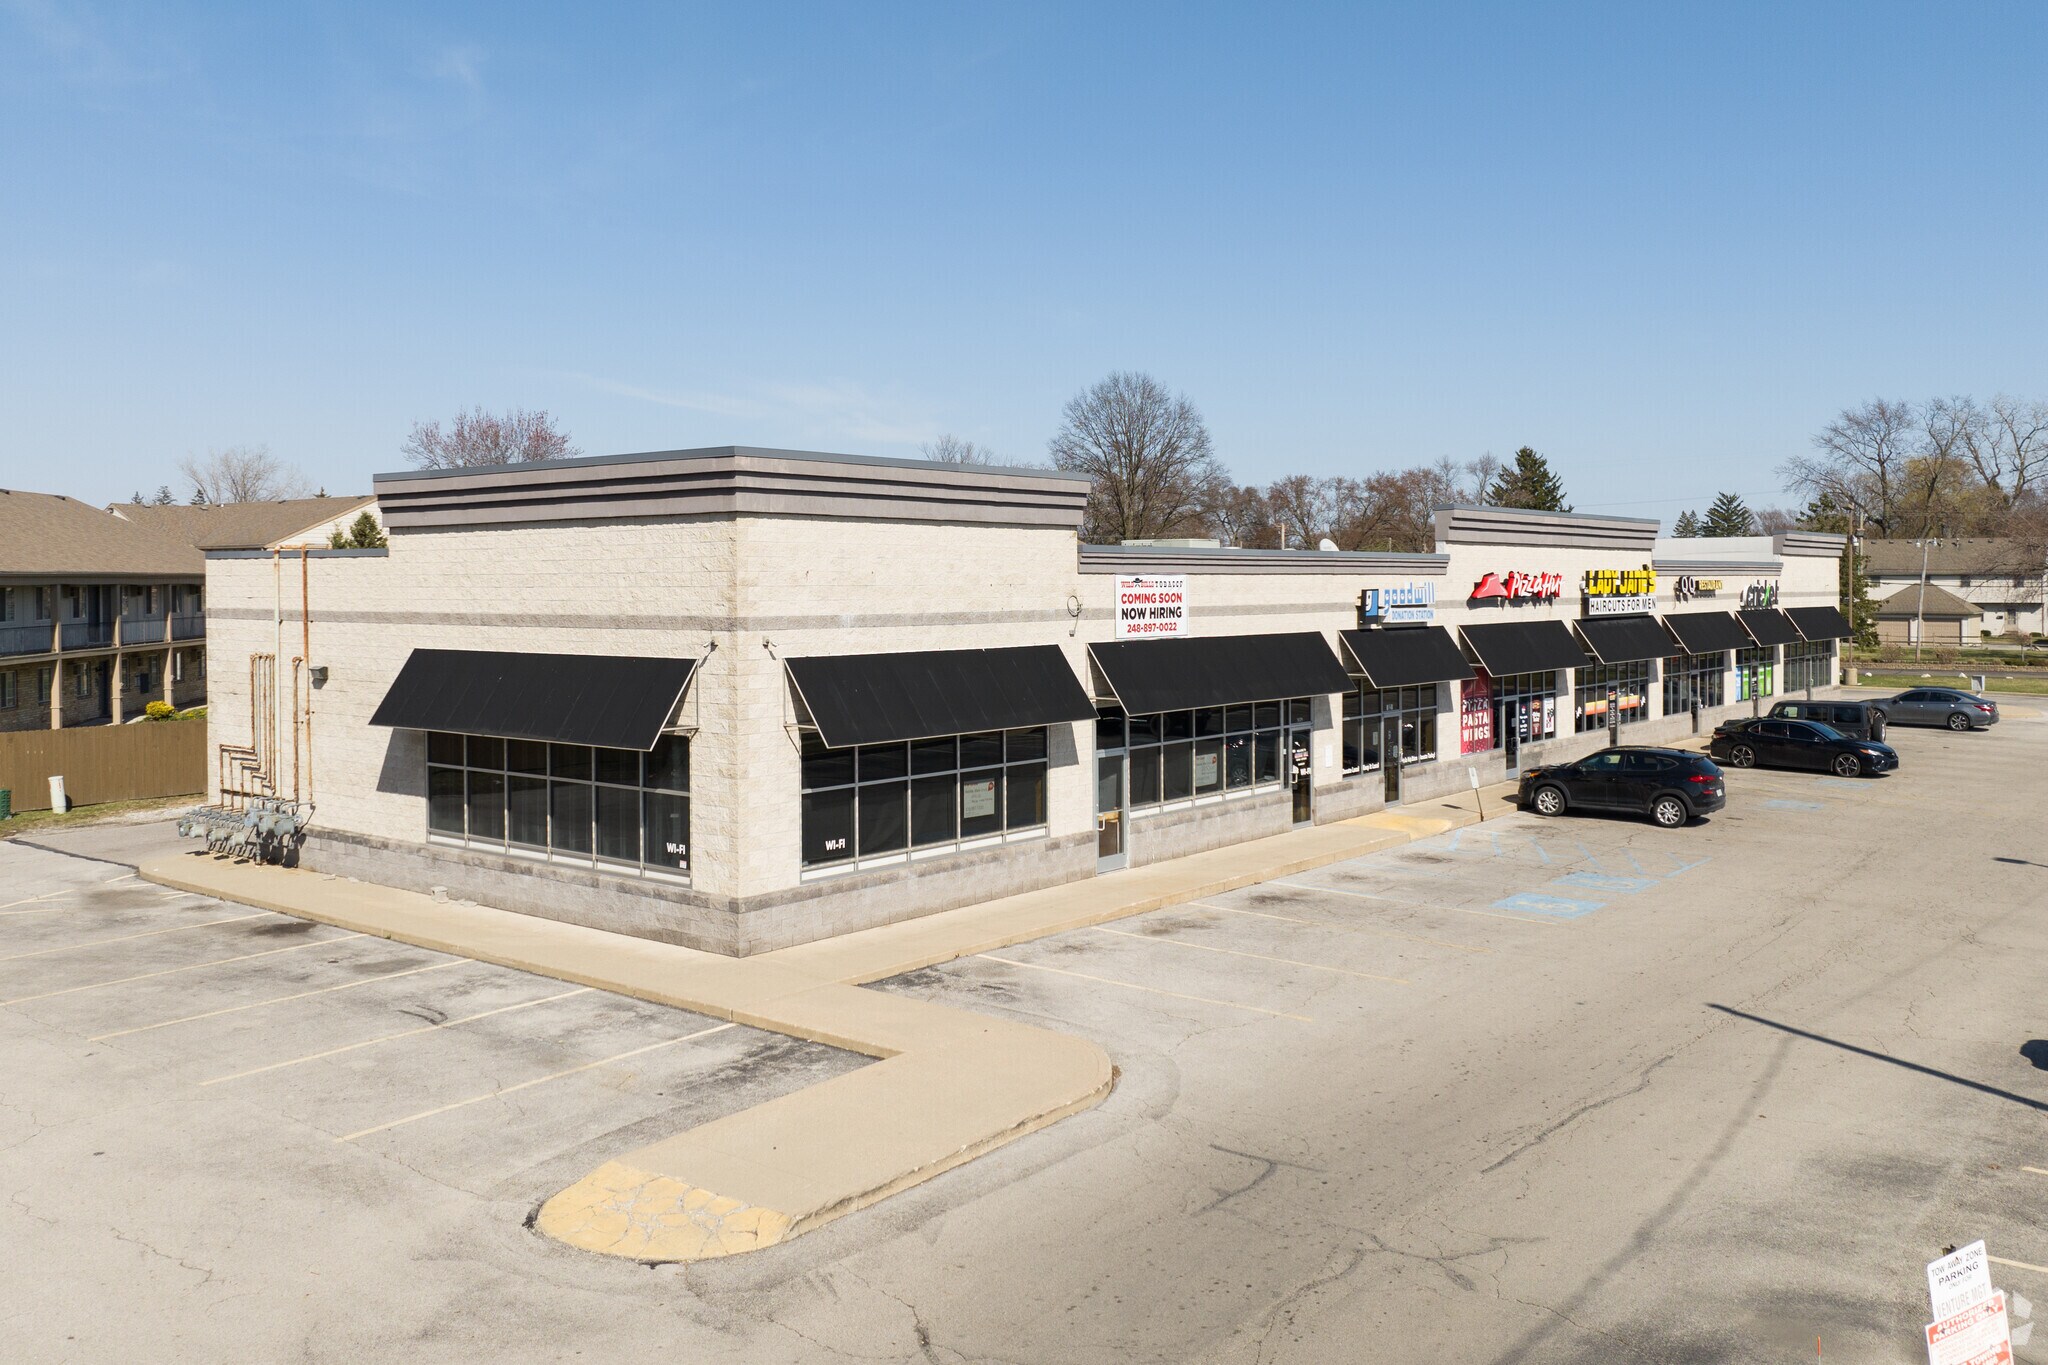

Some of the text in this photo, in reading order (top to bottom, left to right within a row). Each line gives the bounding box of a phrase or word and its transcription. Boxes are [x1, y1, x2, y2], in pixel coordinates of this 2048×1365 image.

[1509, 572, 1565, 599] Pizza Hut
[1589, 570, 1618, 594] LADY
[1121, 592, 1183, 604] COMING SOON
[1384, 582, 1435, 615] goodwill
[1590, 598, 1657, 613] HAIRCUTS FOR MEN
[1121, 606, 1182, 620] NOW HIRING
[1391, 609, 1434, 621] DONATION STATION
[1127, 622, 1177, 633] 248-897-0022
[1462, 712, 1489, 728] PASTA
[1462, 726, 1490, 742] WINGS
[1931, 1247, 1983, 1278] TOW AWAY ZONE
[1938, 1261, 1979, 1287] PARKING
[1936, 1290, 1970, 1318] VENTURE
[1936, 1299, 1995, 1331] AUTHORIZED
[1932, 1317, 1975, 1343] PARKING
[1975, 1304, 2000, 1323] ONLY
